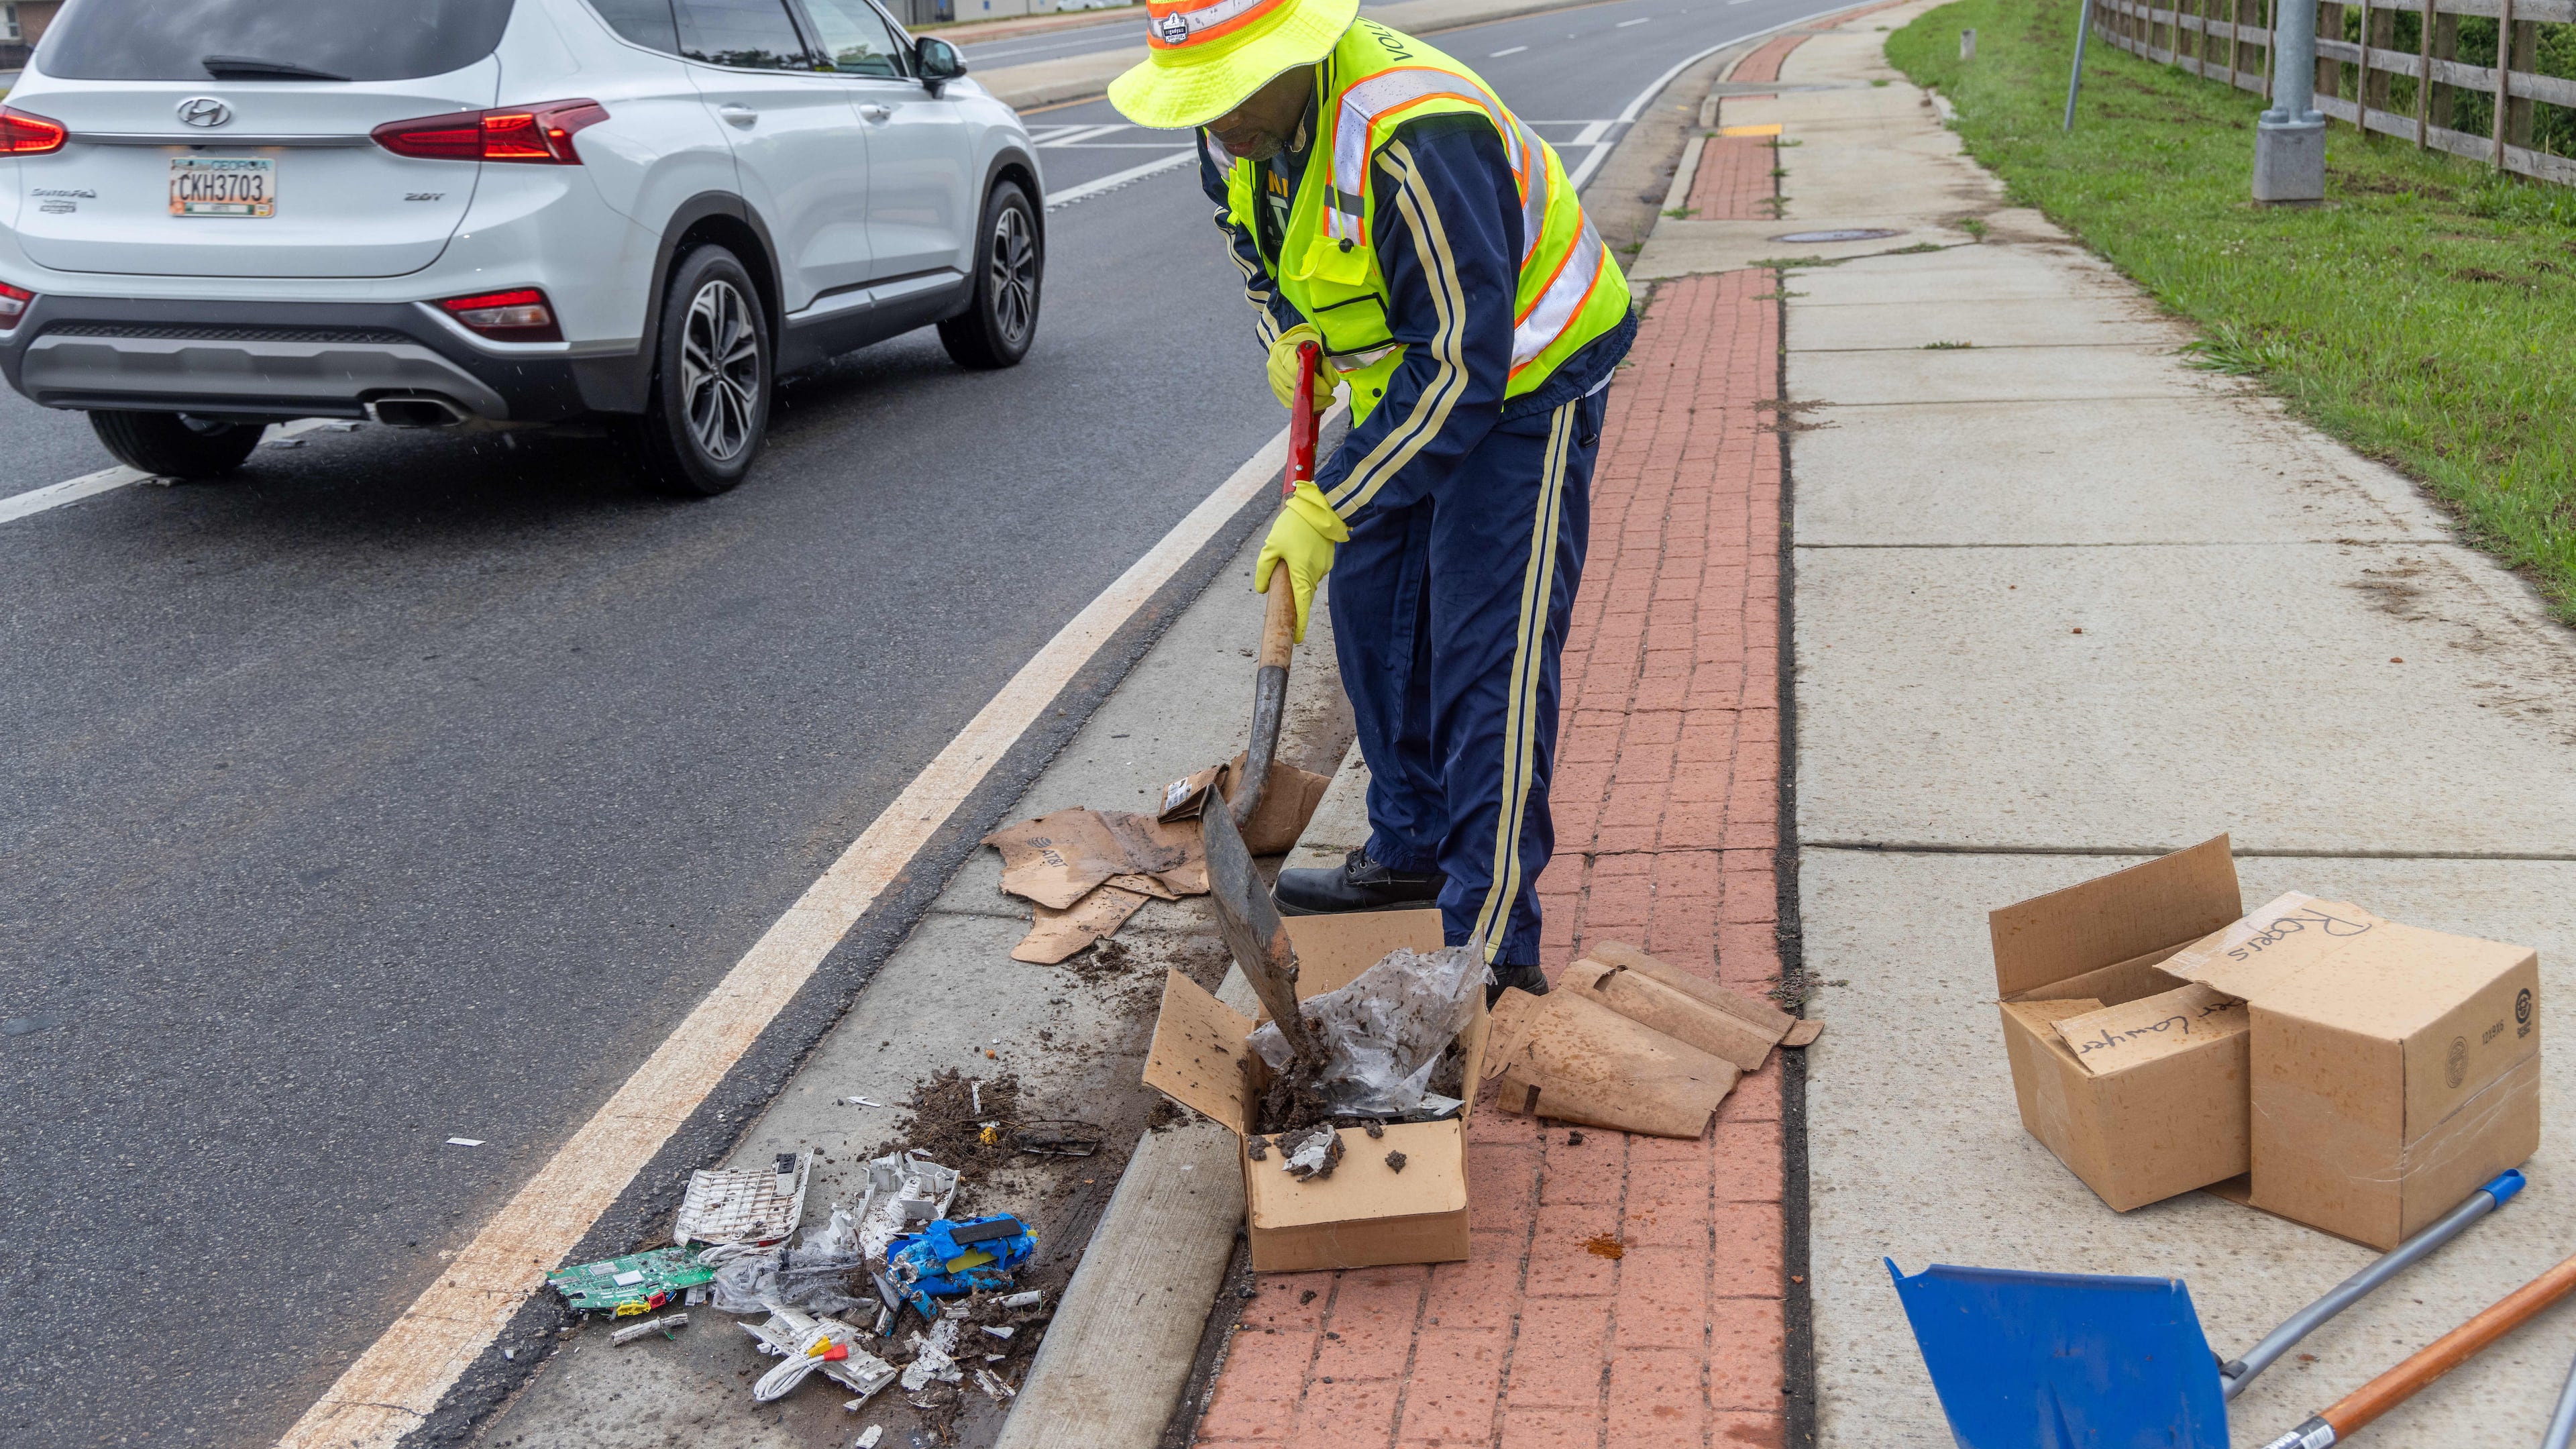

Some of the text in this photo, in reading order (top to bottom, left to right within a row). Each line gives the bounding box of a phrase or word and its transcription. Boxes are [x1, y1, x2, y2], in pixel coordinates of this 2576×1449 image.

[179, 173, 263, 201] CKH3703
[1042, 850, 1068, 867] AT&T
[2227, 908, 2372, 961] Rogers
